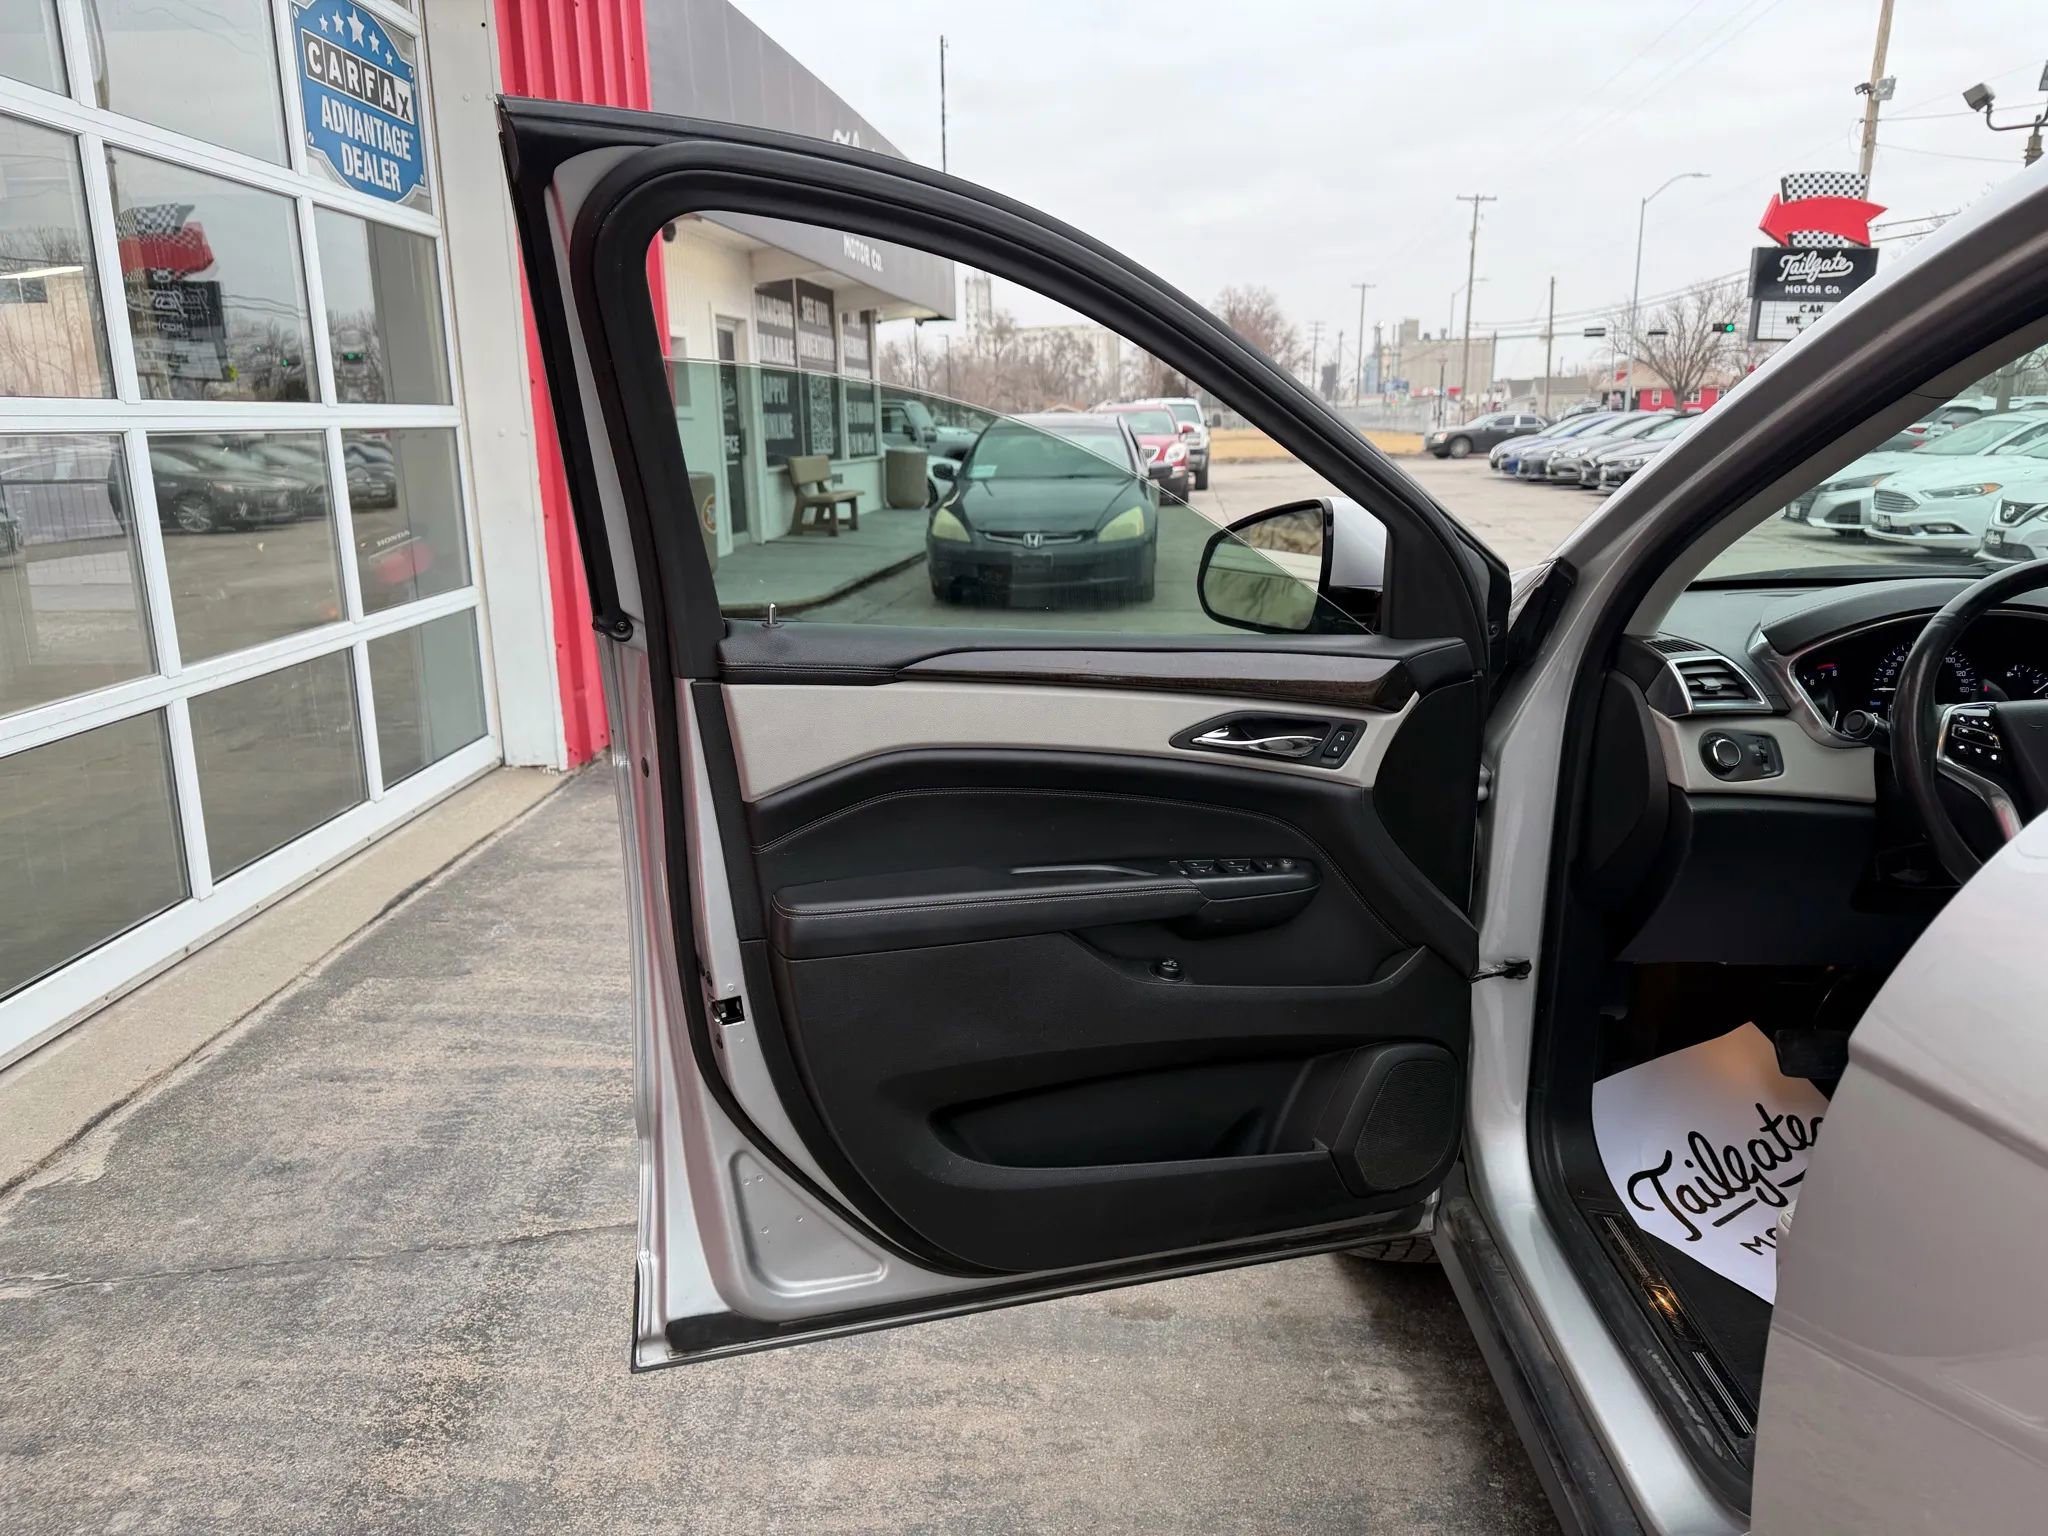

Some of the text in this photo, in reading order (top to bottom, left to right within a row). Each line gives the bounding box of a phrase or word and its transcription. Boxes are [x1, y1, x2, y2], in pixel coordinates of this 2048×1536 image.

[307, 39, 412, 121] CARFAX
[321, 95, 412, 162] ADVANTAGE
[340, 143, 402, 193] DEALER
[1776, 250, 1854, 283] Tailgate
[1785, 285, 1822, 295] MOTOR
[1786, 316, 1801, 324] WE
[1799, 304, 1824, 313] CAN
